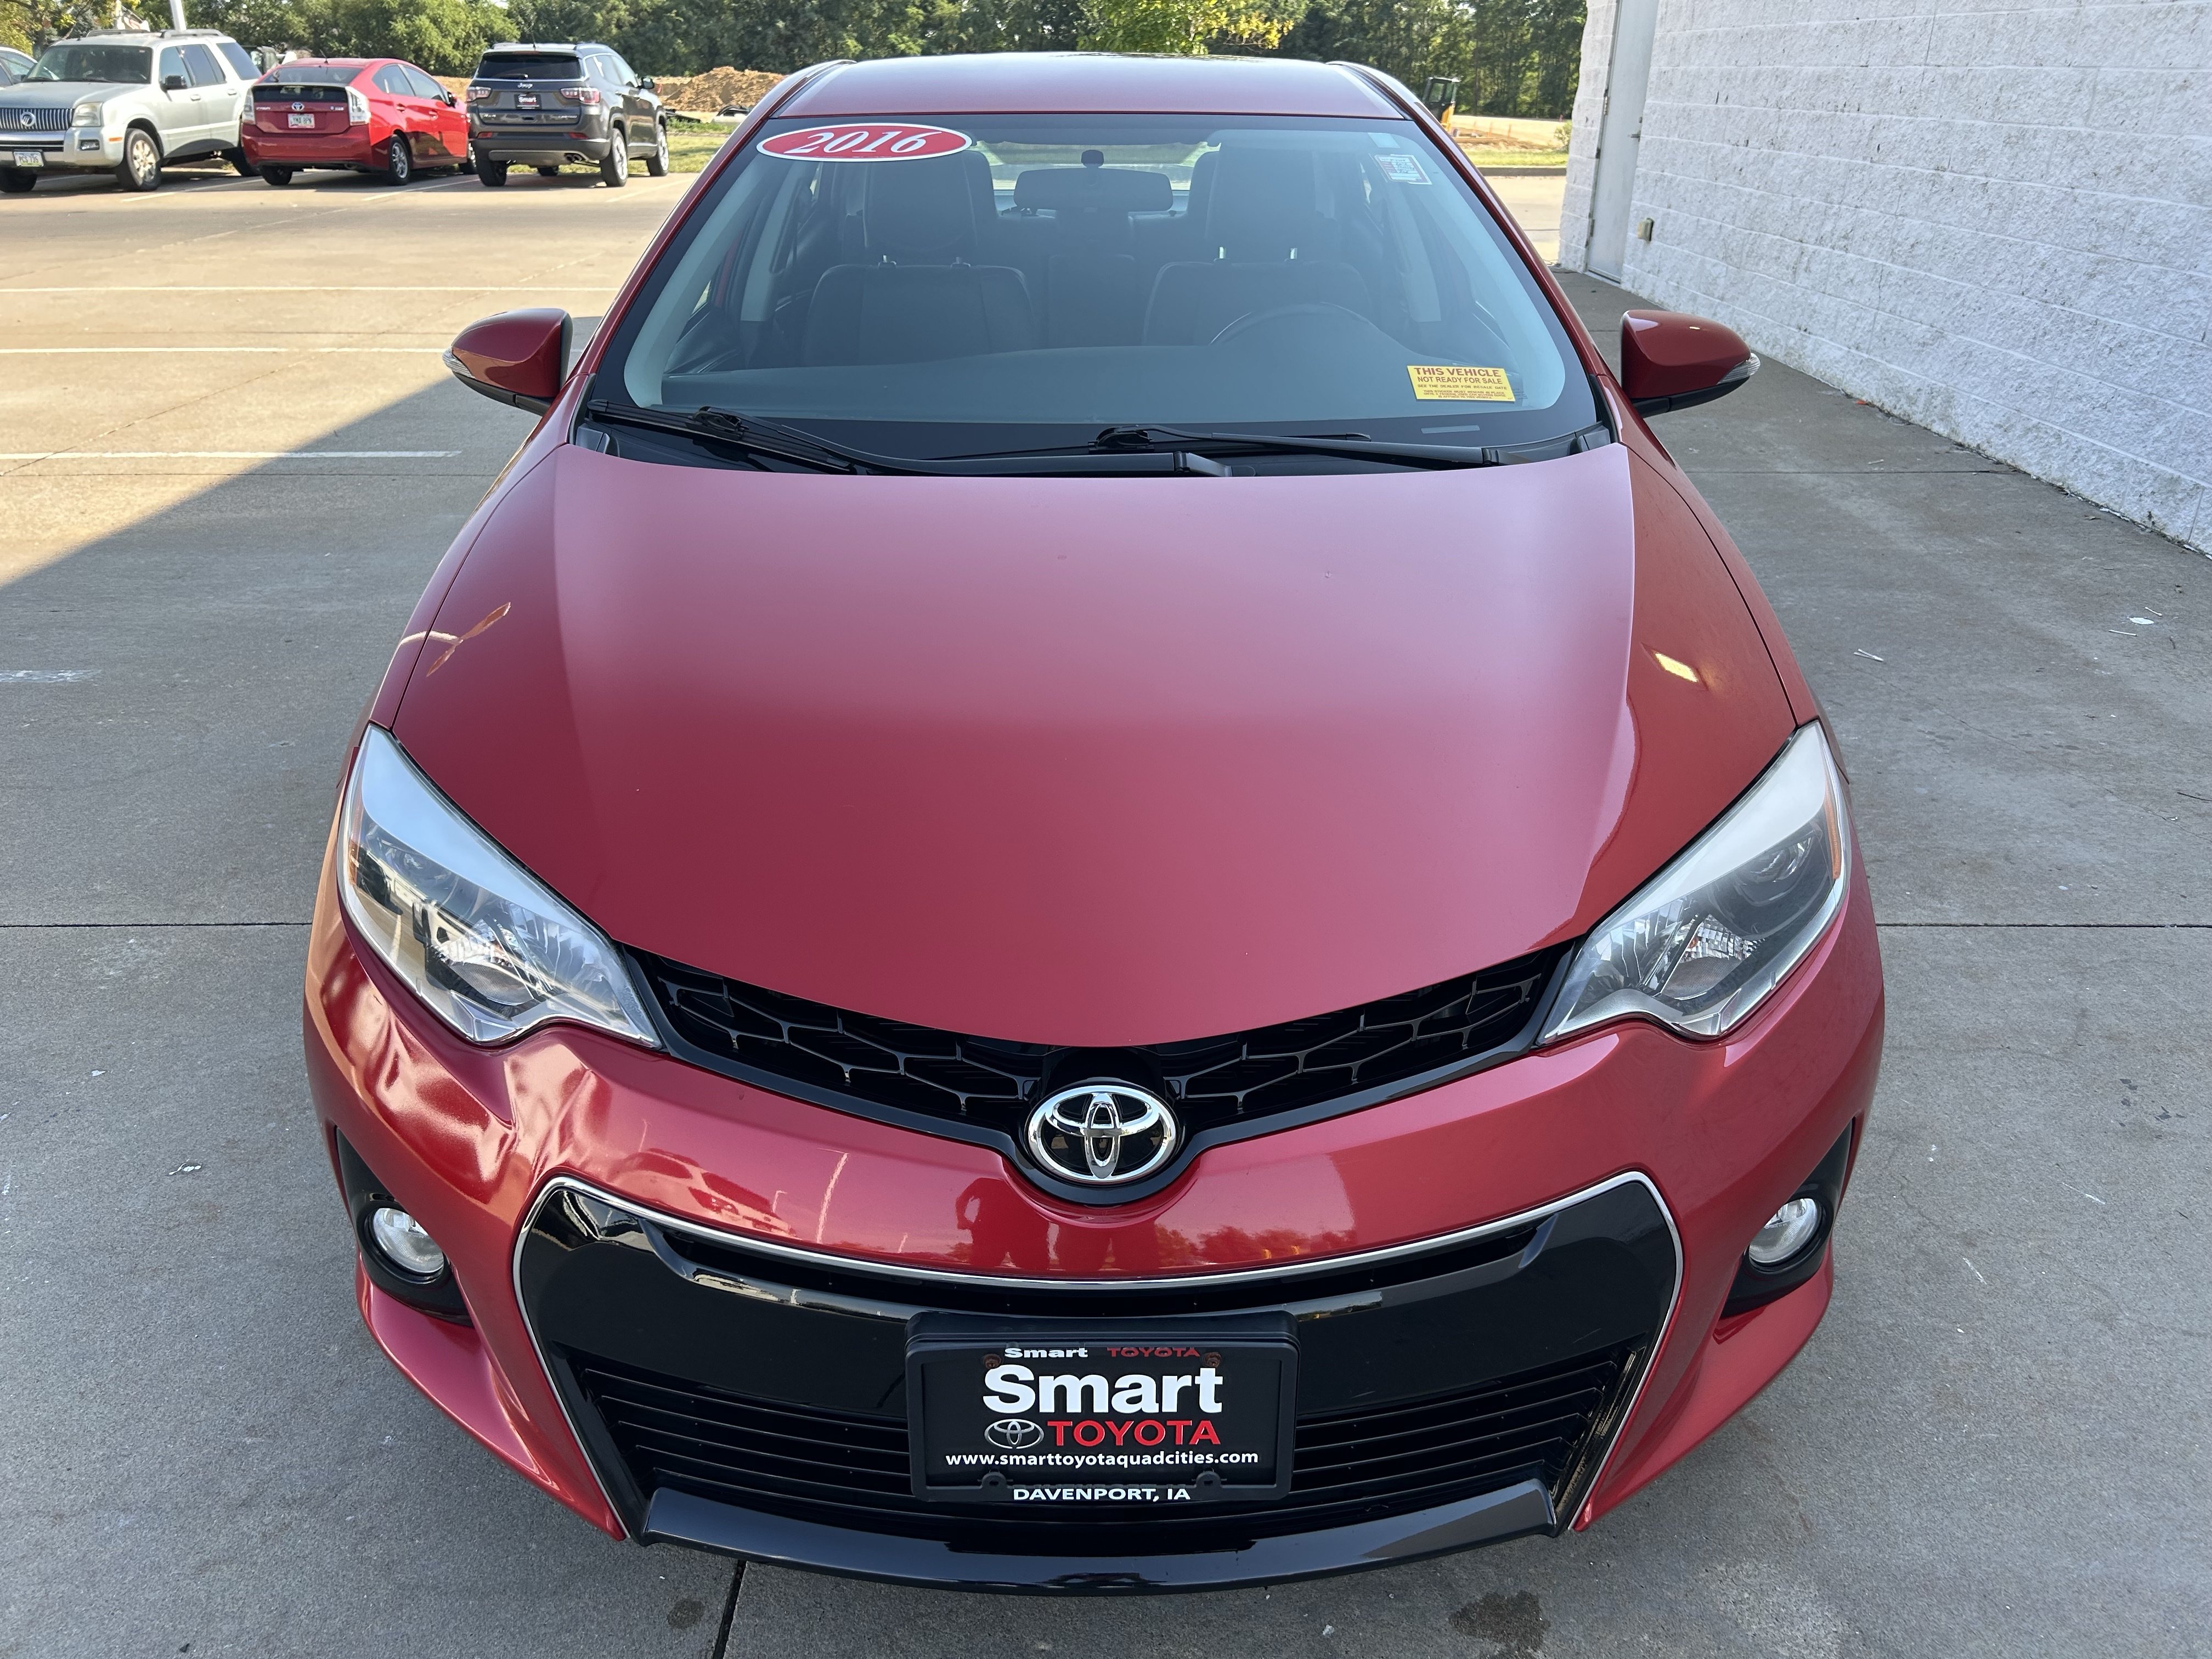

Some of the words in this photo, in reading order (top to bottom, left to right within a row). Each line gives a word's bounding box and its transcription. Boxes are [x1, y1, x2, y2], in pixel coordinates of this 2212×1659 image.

[783, 131, 942, 154] 2016
[1446, 368, 1502, 377] VEHICLE
[1004, 1347, 1088, 1358] Smart
[1107, 1347, 1201, 1357] TOYOTA
[983, 1364, 1223, 1414] Smart
[1047, 1419, 1221, 1447] TOYOTA
[945, 1451, 1259, 1469] www.smarttoyotaquadcities.com
[1013, 1488, 1160, 1502] DAVENPORT,
[1167, 1488, 1191, 1500] IA
